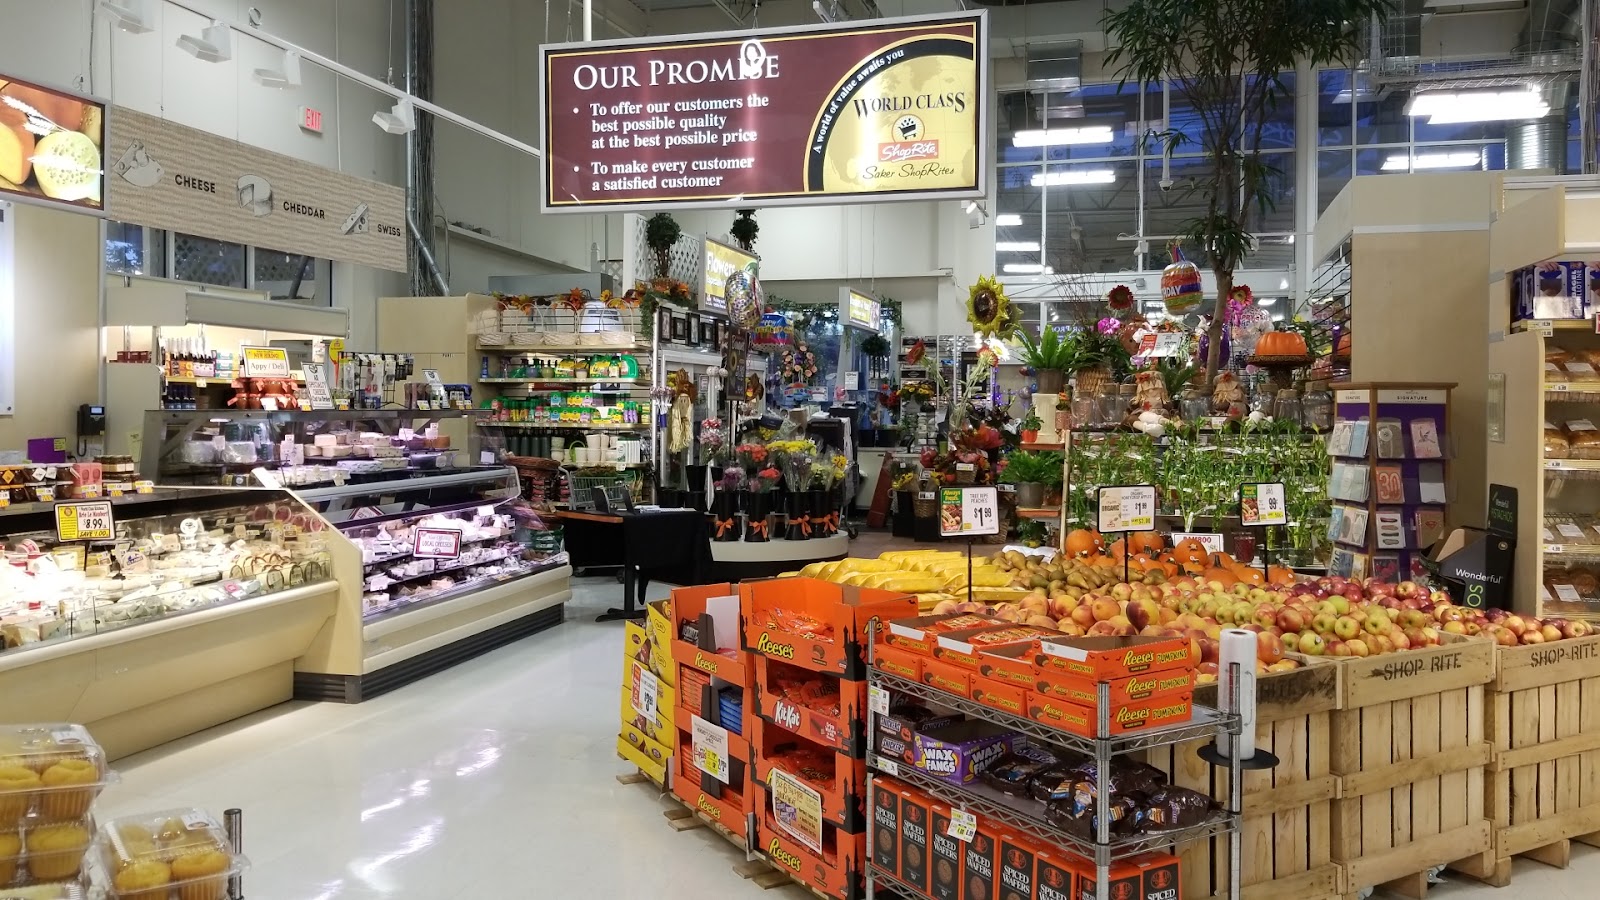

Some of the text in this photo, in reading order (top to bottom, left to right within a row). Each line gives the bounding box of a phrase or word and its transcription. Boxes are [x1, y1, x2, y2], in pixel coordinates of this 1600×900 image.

[573, 55, 780, 90] OUR PROMISE
[590, 94, 769, 117] To offer our customers the
[812, 49, 905, 154] A world of value awaits you
[854, 92, 965, 119] WORLD CLASS
[305, 108, 322, 131] EXIT
[592, 113, 727, 134] best possible quality
[591, 129, 758, 149] at the best possible price
[881, 142, 937, 163] ShopRite
[591, 156, 755, 175] To make every customer
[862, 162, 955, 180] Saker ShopRites
[591, 175, 723, 191] a satisfied customer
[174, 173, 401, 237] CHEESE CHEDDAR SWISS
[251, 362, 267, 371] Appy
[272, 362, 284, 370] Deli
[1380, 471, 1400, 494] 30
[1101, 504, 1120, 512] ORGANIC
[1455, 568, 1501, 584] Wonderful
[758, 632, 795, 660] Reese's
[1530, 642, 1599, 668] SHOP RITE
[694, 652, 718, 673] Reese's
[1123, 648, 1188, 666] Reese's PUMPKINS
[1384, 652, 1462, 681] SHOP RITE
[1126, 677, 1157, 694] Reese's
[1116, 703, 1187, 723] Reese's PUMPKINS
[924, 748, 953, 761] WAX
[971, 742, 1003, 763] WAX
[926, 759, 956, 773] FANGS
[697, 793, 721, 820] Reese's
[876, 805, 895, 821] SPICED
[875, 812, 896, 830] WAFERS
[903, 819, 924, 836] SPICED
[903, 827, 925, 845] WAFERS
[934, 834, 956, 851] SPICED
[769, 837, 801, 873] Reese's
[934, 840, 958, 860] WAFERS
[967, 849, 990, 868] SPICED
[967, 857, 991, 878] WAFERS
[1003, 865, 1030, 884] SPICED
[1002, 873, 1030, 894] WAFERS
[1147, 888, 1176, 900] SPICED
